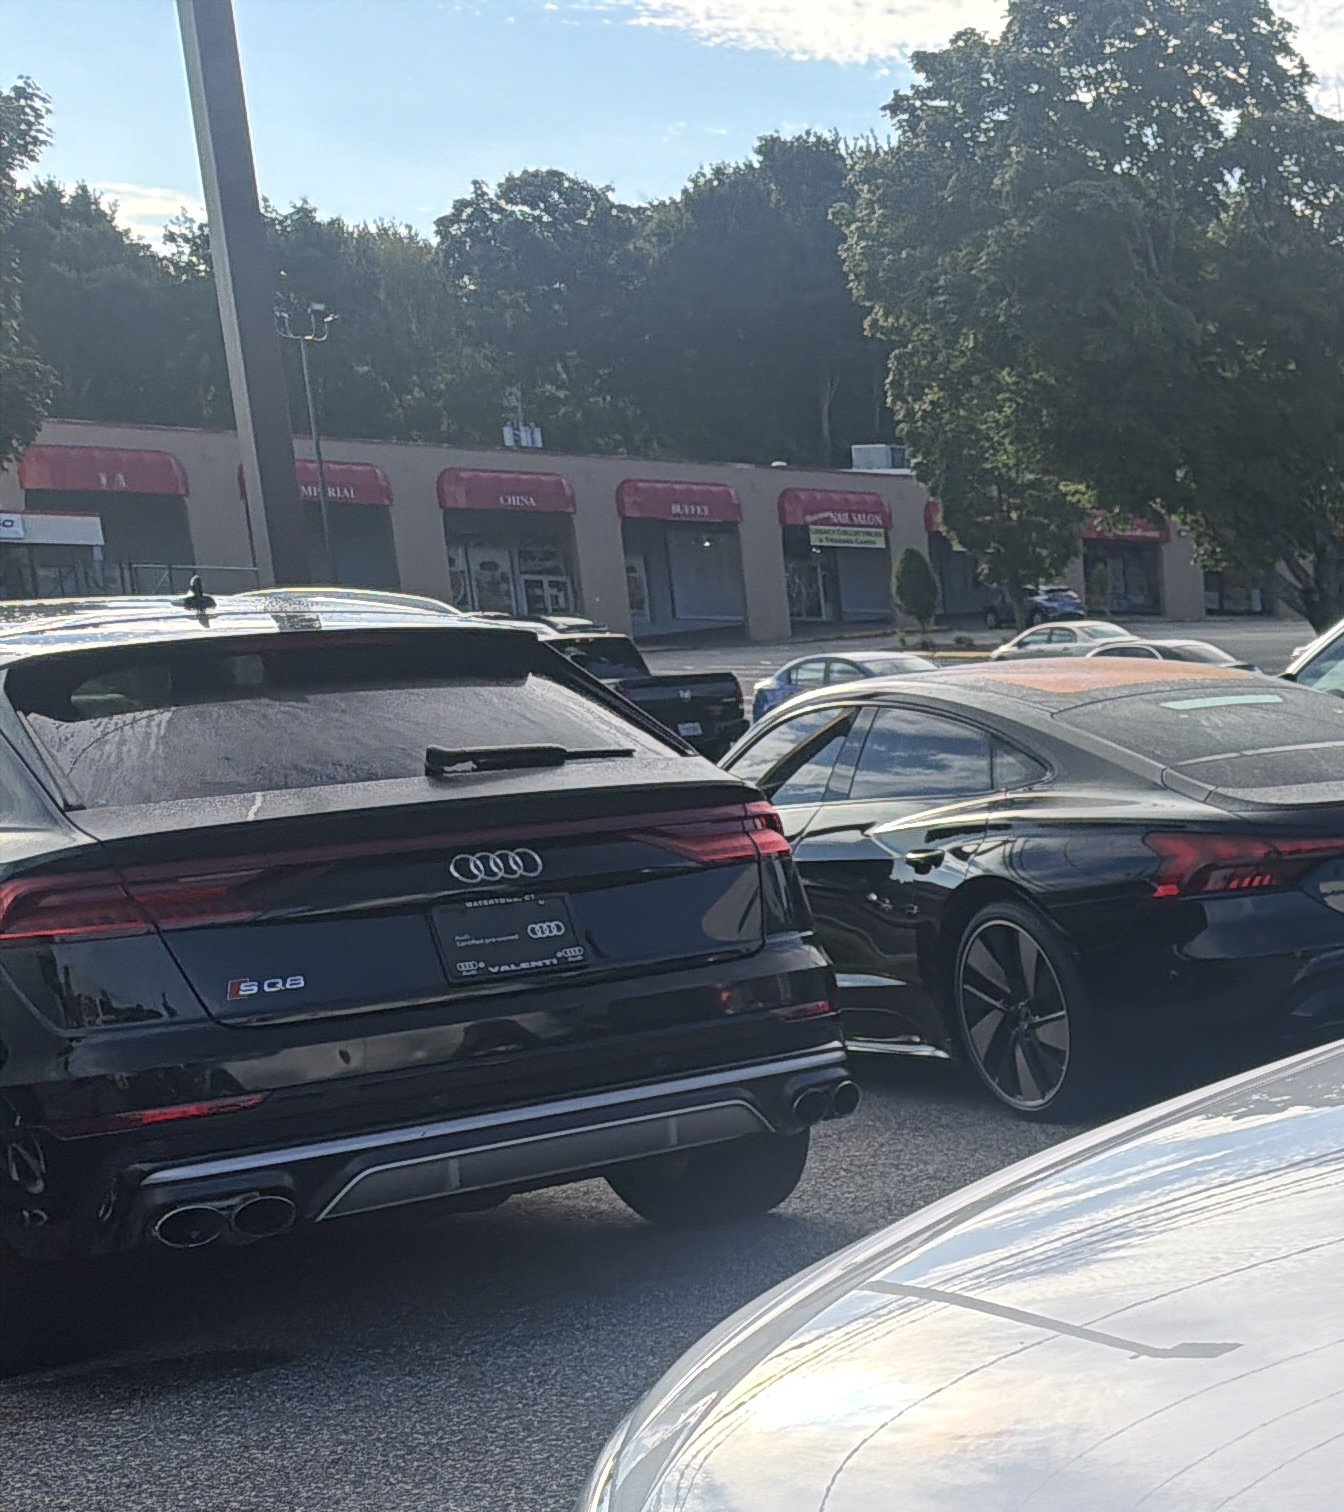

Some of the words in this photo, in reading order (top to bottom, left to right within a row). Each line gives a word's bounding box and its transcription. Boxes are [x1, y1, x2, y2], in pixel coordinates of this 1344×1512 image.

[499, 495, 536, 507] CHINA
[851, 513, 884, 526] SALON
[488, 957, 558, 973] VALENTI
